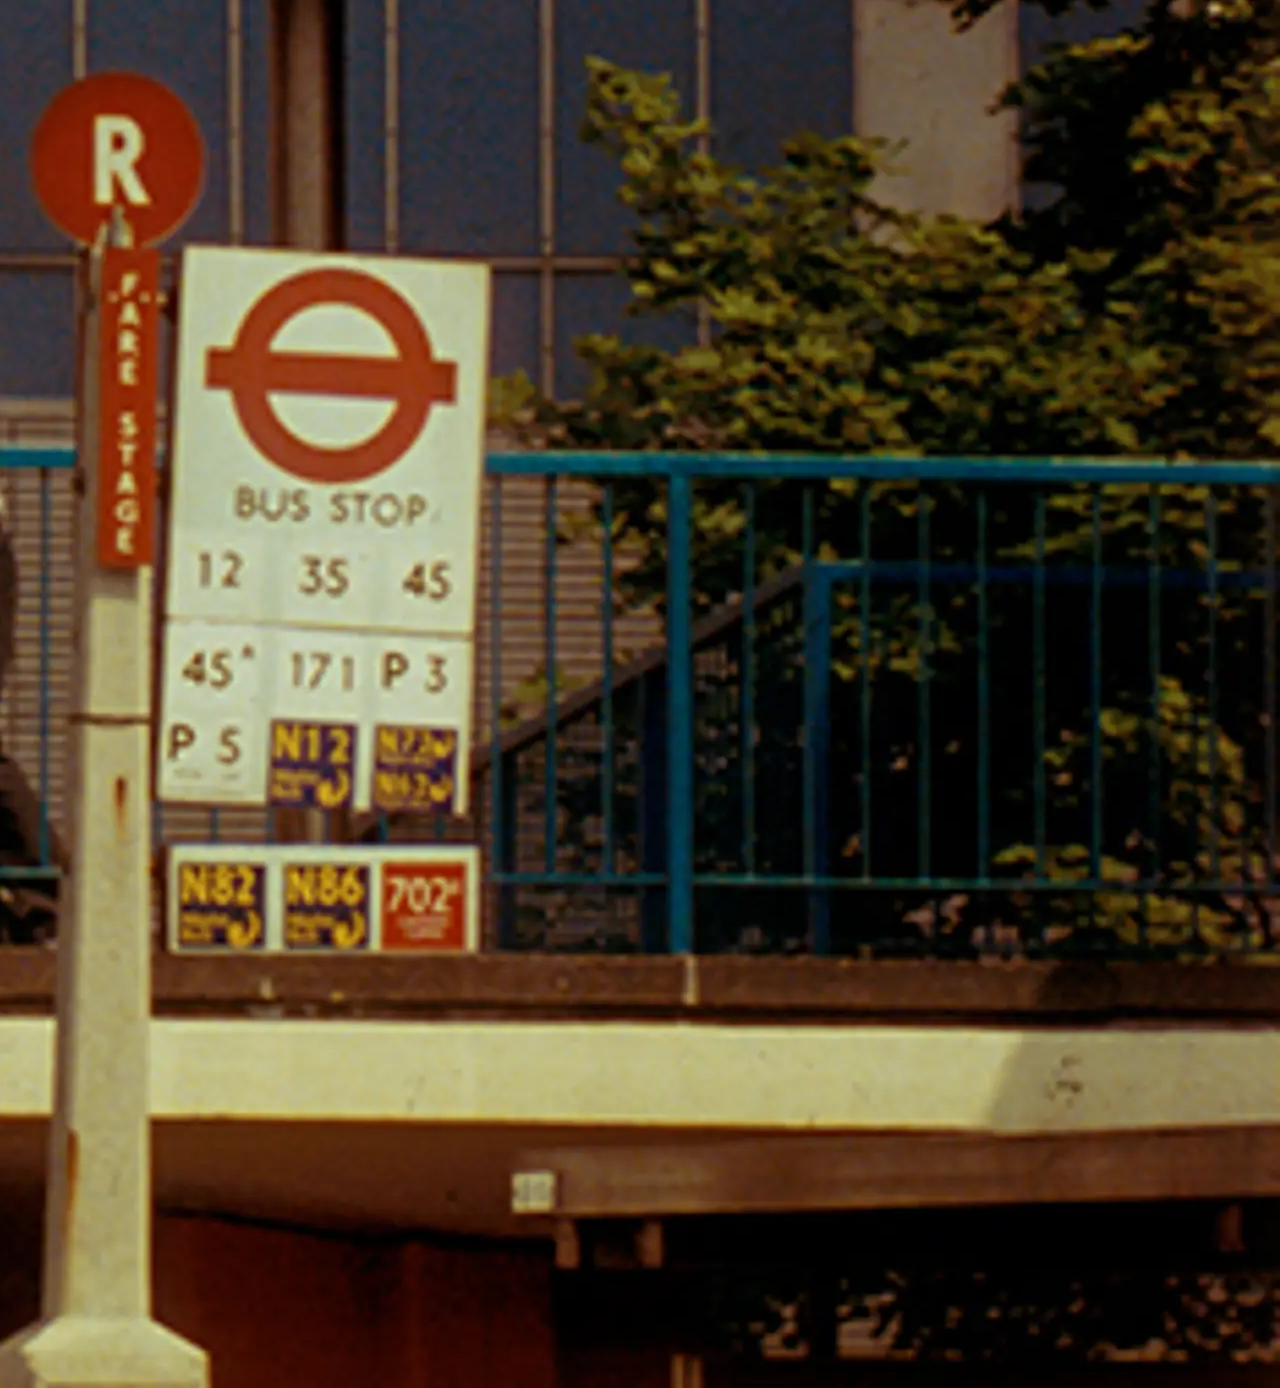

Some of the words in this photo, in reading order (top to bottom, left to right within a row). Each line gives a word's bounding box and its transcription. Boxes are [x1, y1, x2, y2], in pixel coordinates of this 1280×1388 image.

[93, 114, 151, 205] R
[116, 271, 142, 386] FARE
[113, 411, 141, 554] STAGE
[234, 485, 311, 523] BUS
[329, 490, 428, 527] STOP
[198, 550, 244, 589] 12
[298, 553, 349, 597] 35
[402, 560, 452, 601] 45
[291, 651, 355, 692] 171
[381, 652, 409, 691] P
[425, 654, 448, 694] 3
[168, 722, 196, 761] P
[274, 723, 351, 764] N12
[180, 864, 257, 906] N82
